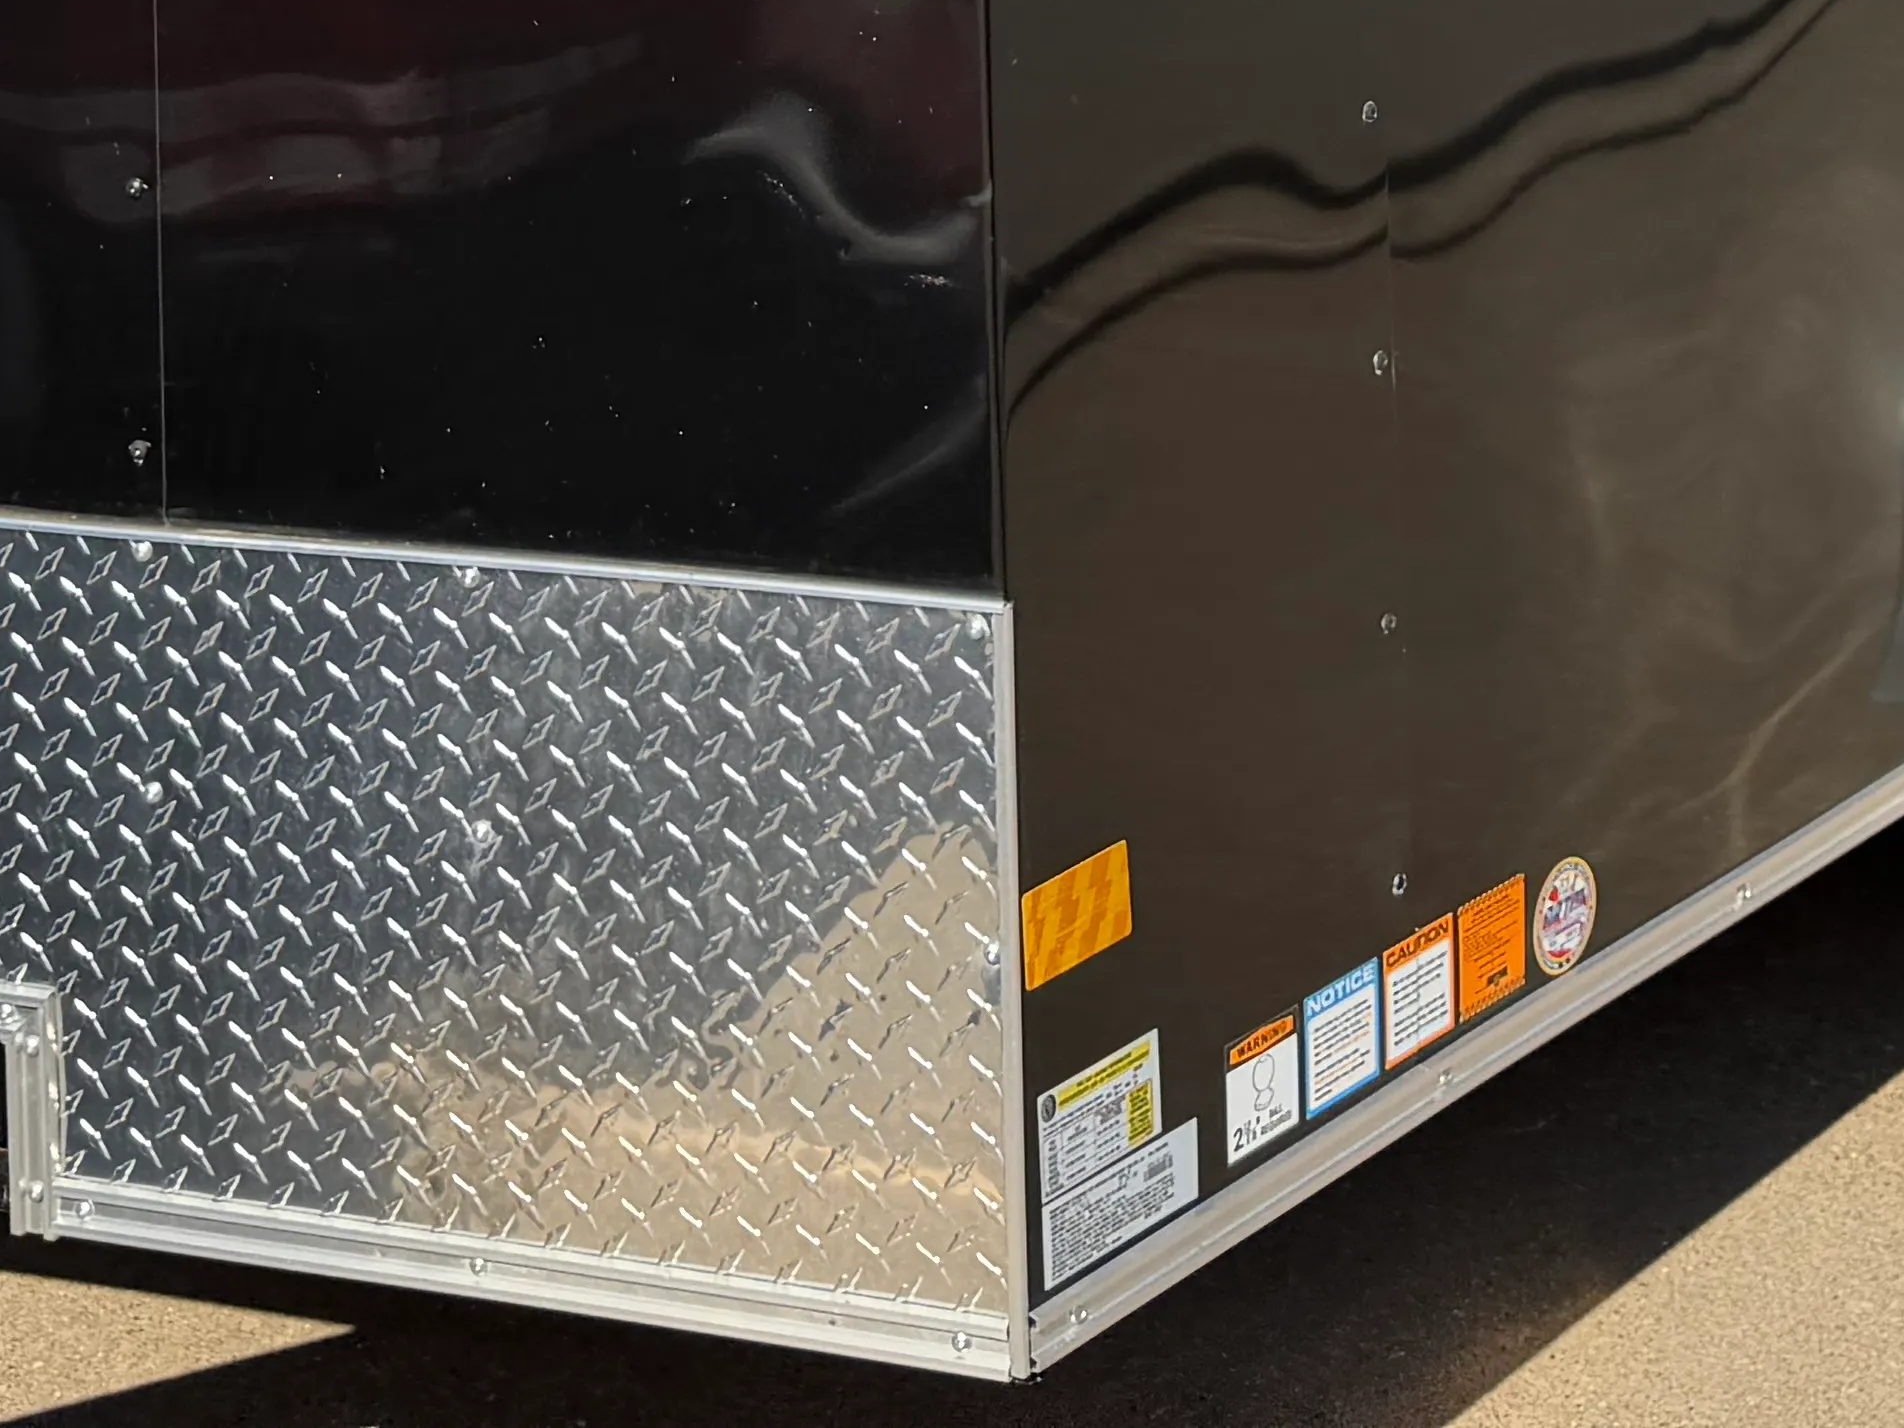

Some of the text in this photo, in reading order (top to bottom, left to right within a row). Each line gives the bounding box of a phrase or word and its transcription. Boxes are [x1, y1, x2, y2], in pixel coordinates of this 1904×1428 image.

[1386, 919, 1449, 967] CAUTION
[1307, 962, 1375, 1016] NOTICE
[1236, 1020, 1288, 1058] WARNING
